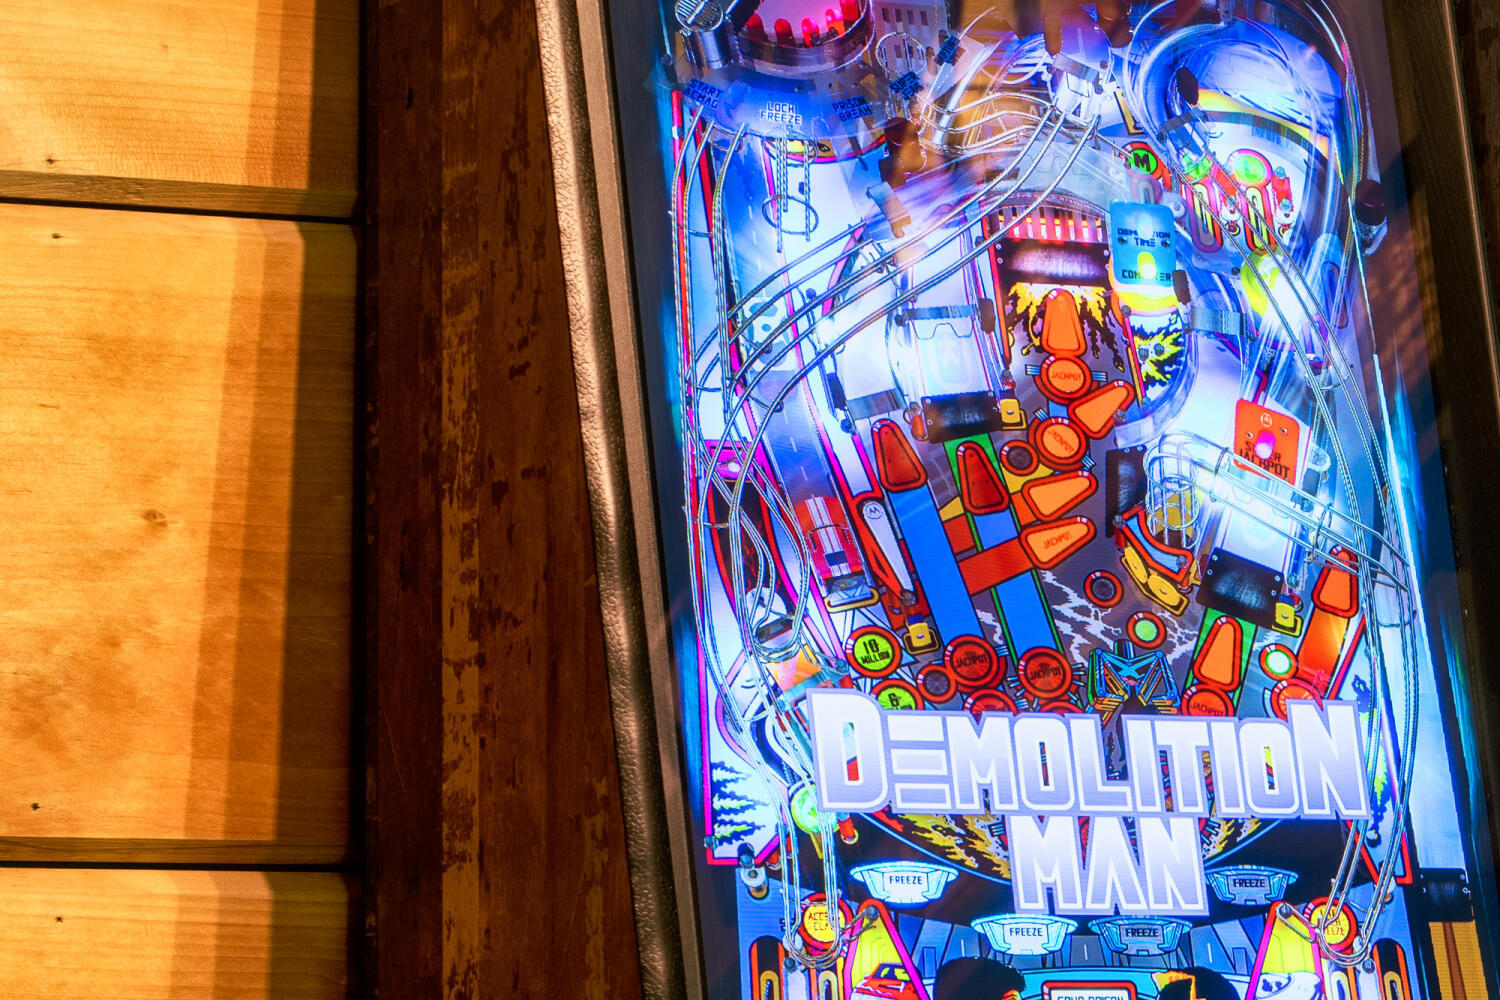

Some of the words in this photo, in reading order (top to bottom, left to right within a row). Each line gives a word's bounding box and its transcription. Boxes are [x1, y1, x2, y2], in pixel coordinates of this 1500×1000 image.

[760, 111, 802, 125] FREEZE
[1134, 237, 1156, 248] TIME
[863, 638, 880, 655] 10
[808, 688, 1371, 819] DEMOLITION
[1006, 812, 1208, 914] MAN
[889, 874, 923, 886] FREEZE
[1232, 878, 1266, 889] FREEZE
[1009, 926, 1043, 938] FREEZE
[1125, 927, 1159, 938] FREEZE
